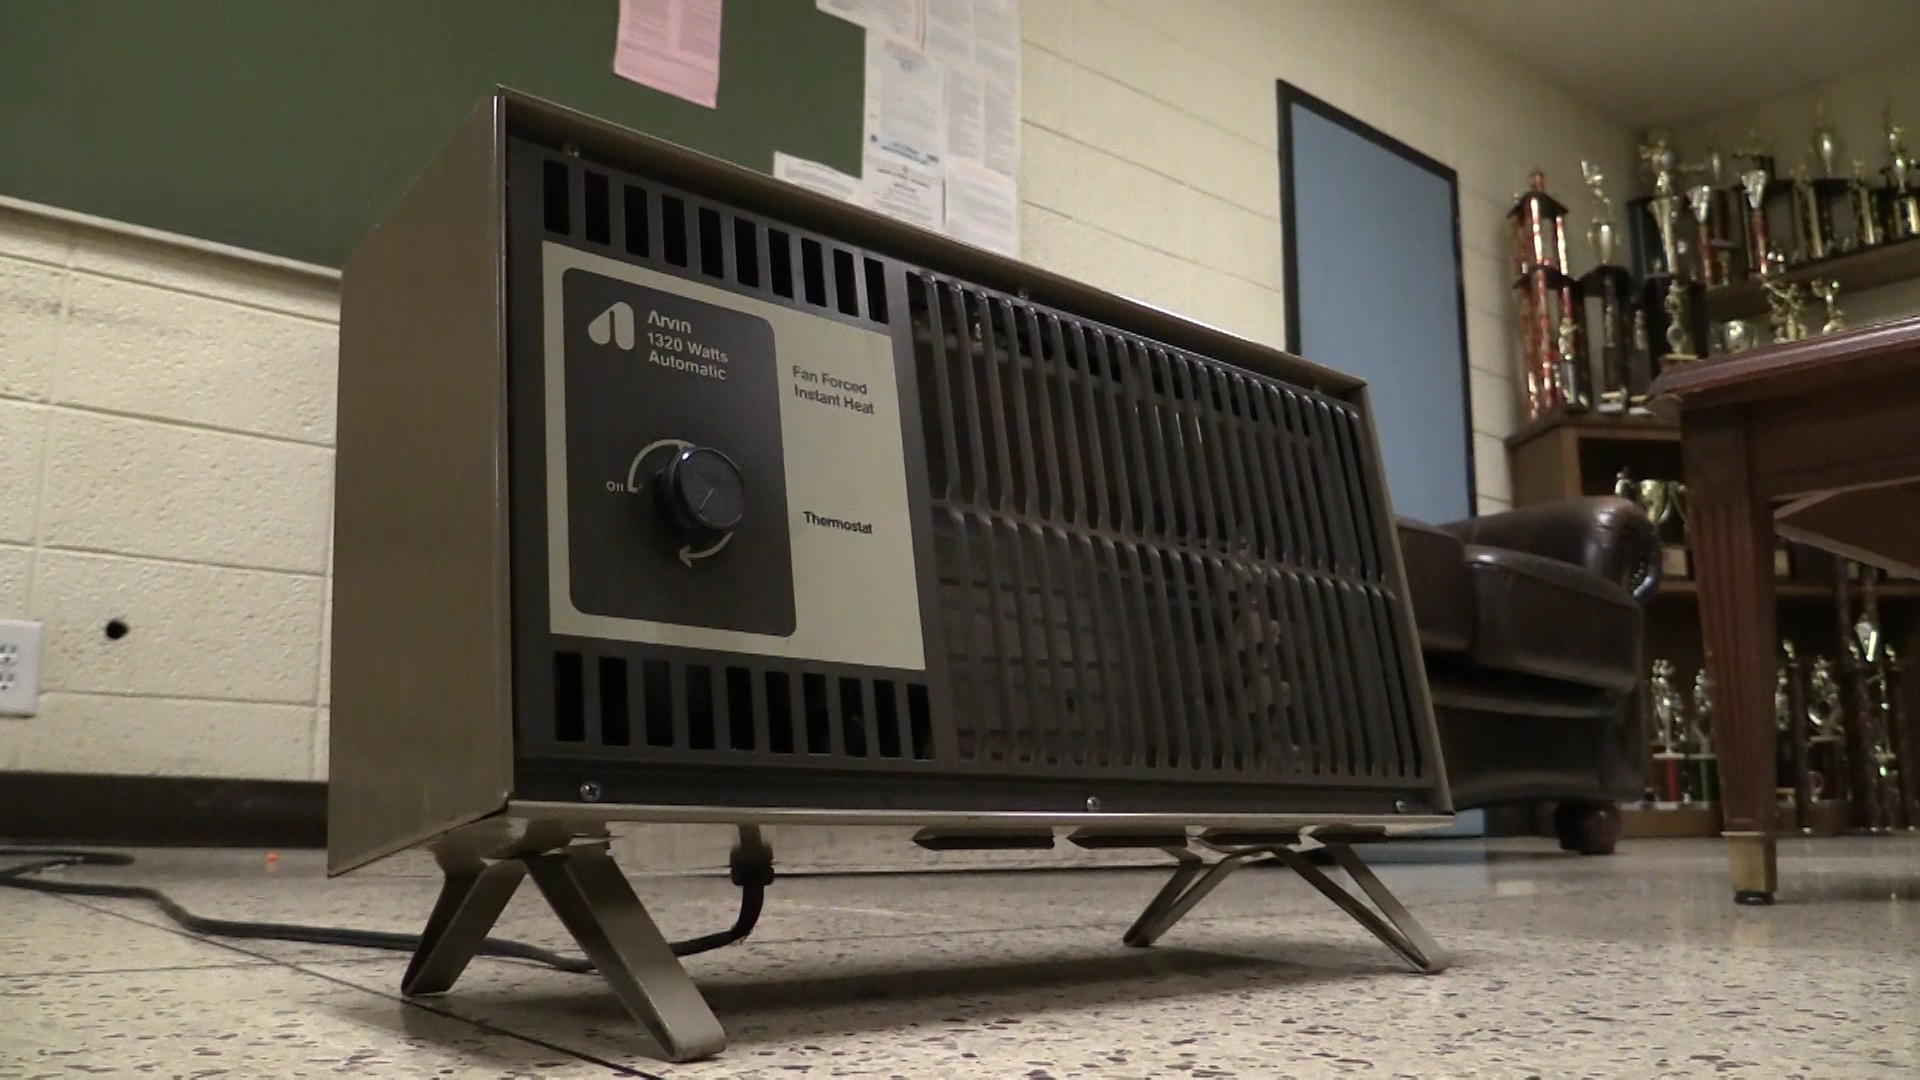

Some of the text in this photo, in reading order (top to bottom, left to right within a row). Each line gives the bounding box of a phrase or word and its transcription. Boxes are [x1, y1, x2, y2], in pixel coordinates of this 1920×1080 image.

[647, 309, 692, 334] Arvin
[647, 331, 729, 364] 1320 Watts
[648, 349, 727, 380] Automatic
[792, 365, 868, 396] Fan Forced
[794, 383, 875, 416] Instant Heat
[803, 511, 873, 535] Thermostat
